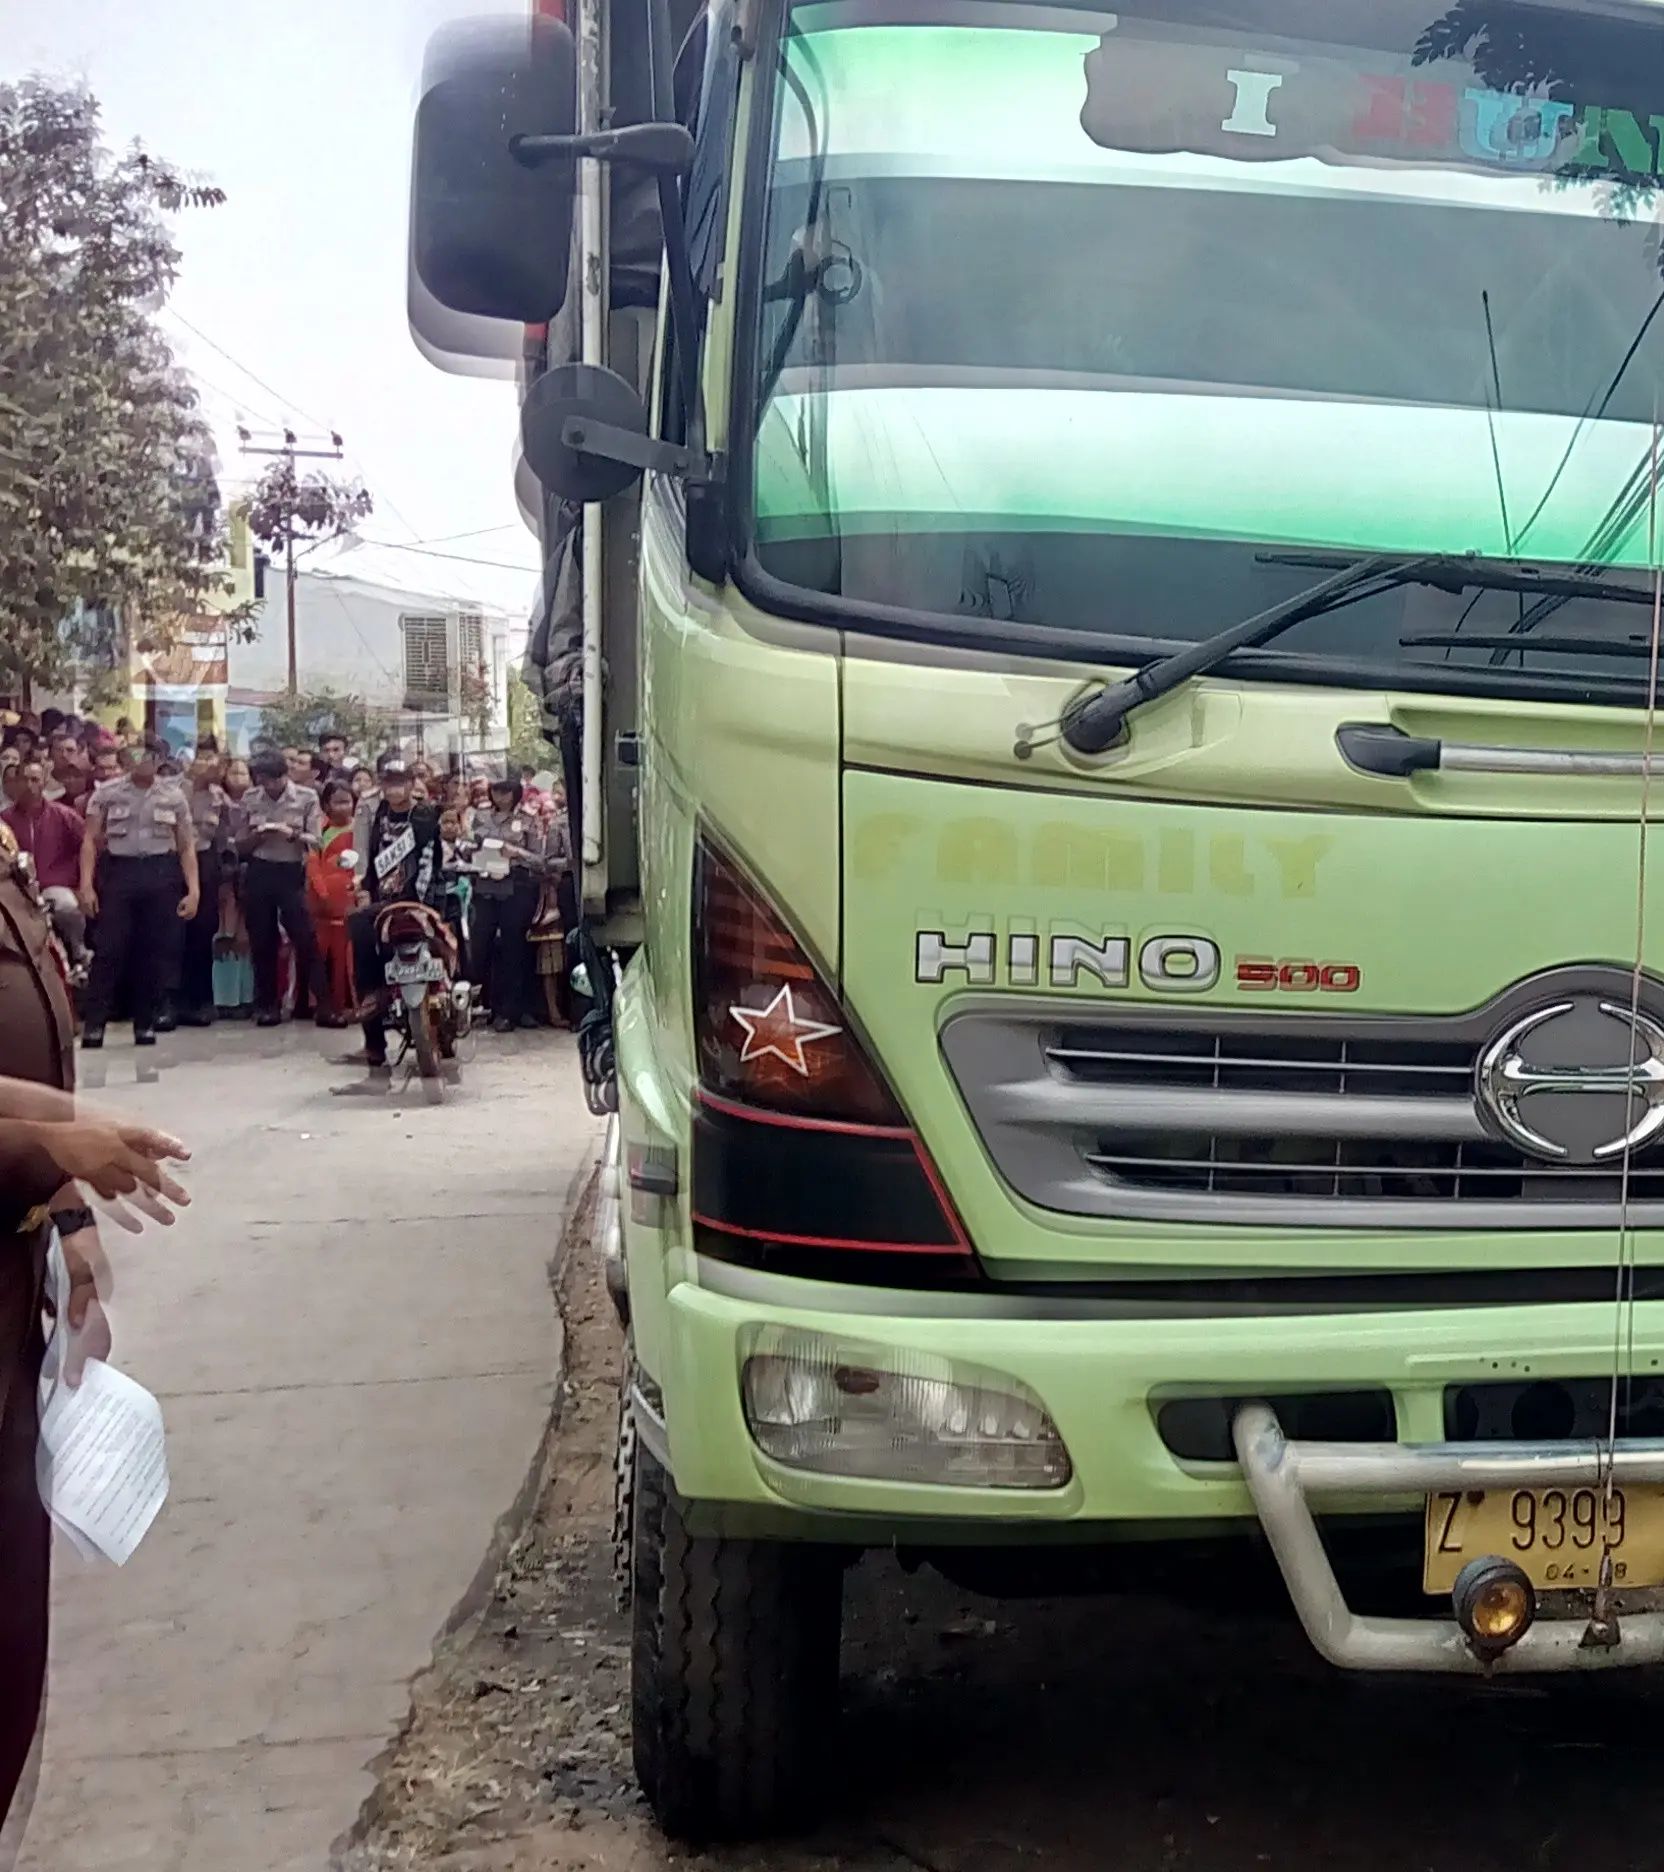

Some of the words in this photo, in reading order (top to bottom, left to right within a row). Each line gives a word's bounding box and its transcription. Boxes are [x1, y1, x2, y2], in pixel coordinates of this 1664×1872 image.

[1221, 69, 1282, 137] I
[915, 929, 1222, 993] HINO
[1236, 957, 1361, 992] 500
[1438, 1491, 1462, 1553] Z
[1511, 1490, 1626, 1550] 9399
[1546, 1562, 1627, 1580] 04-8
